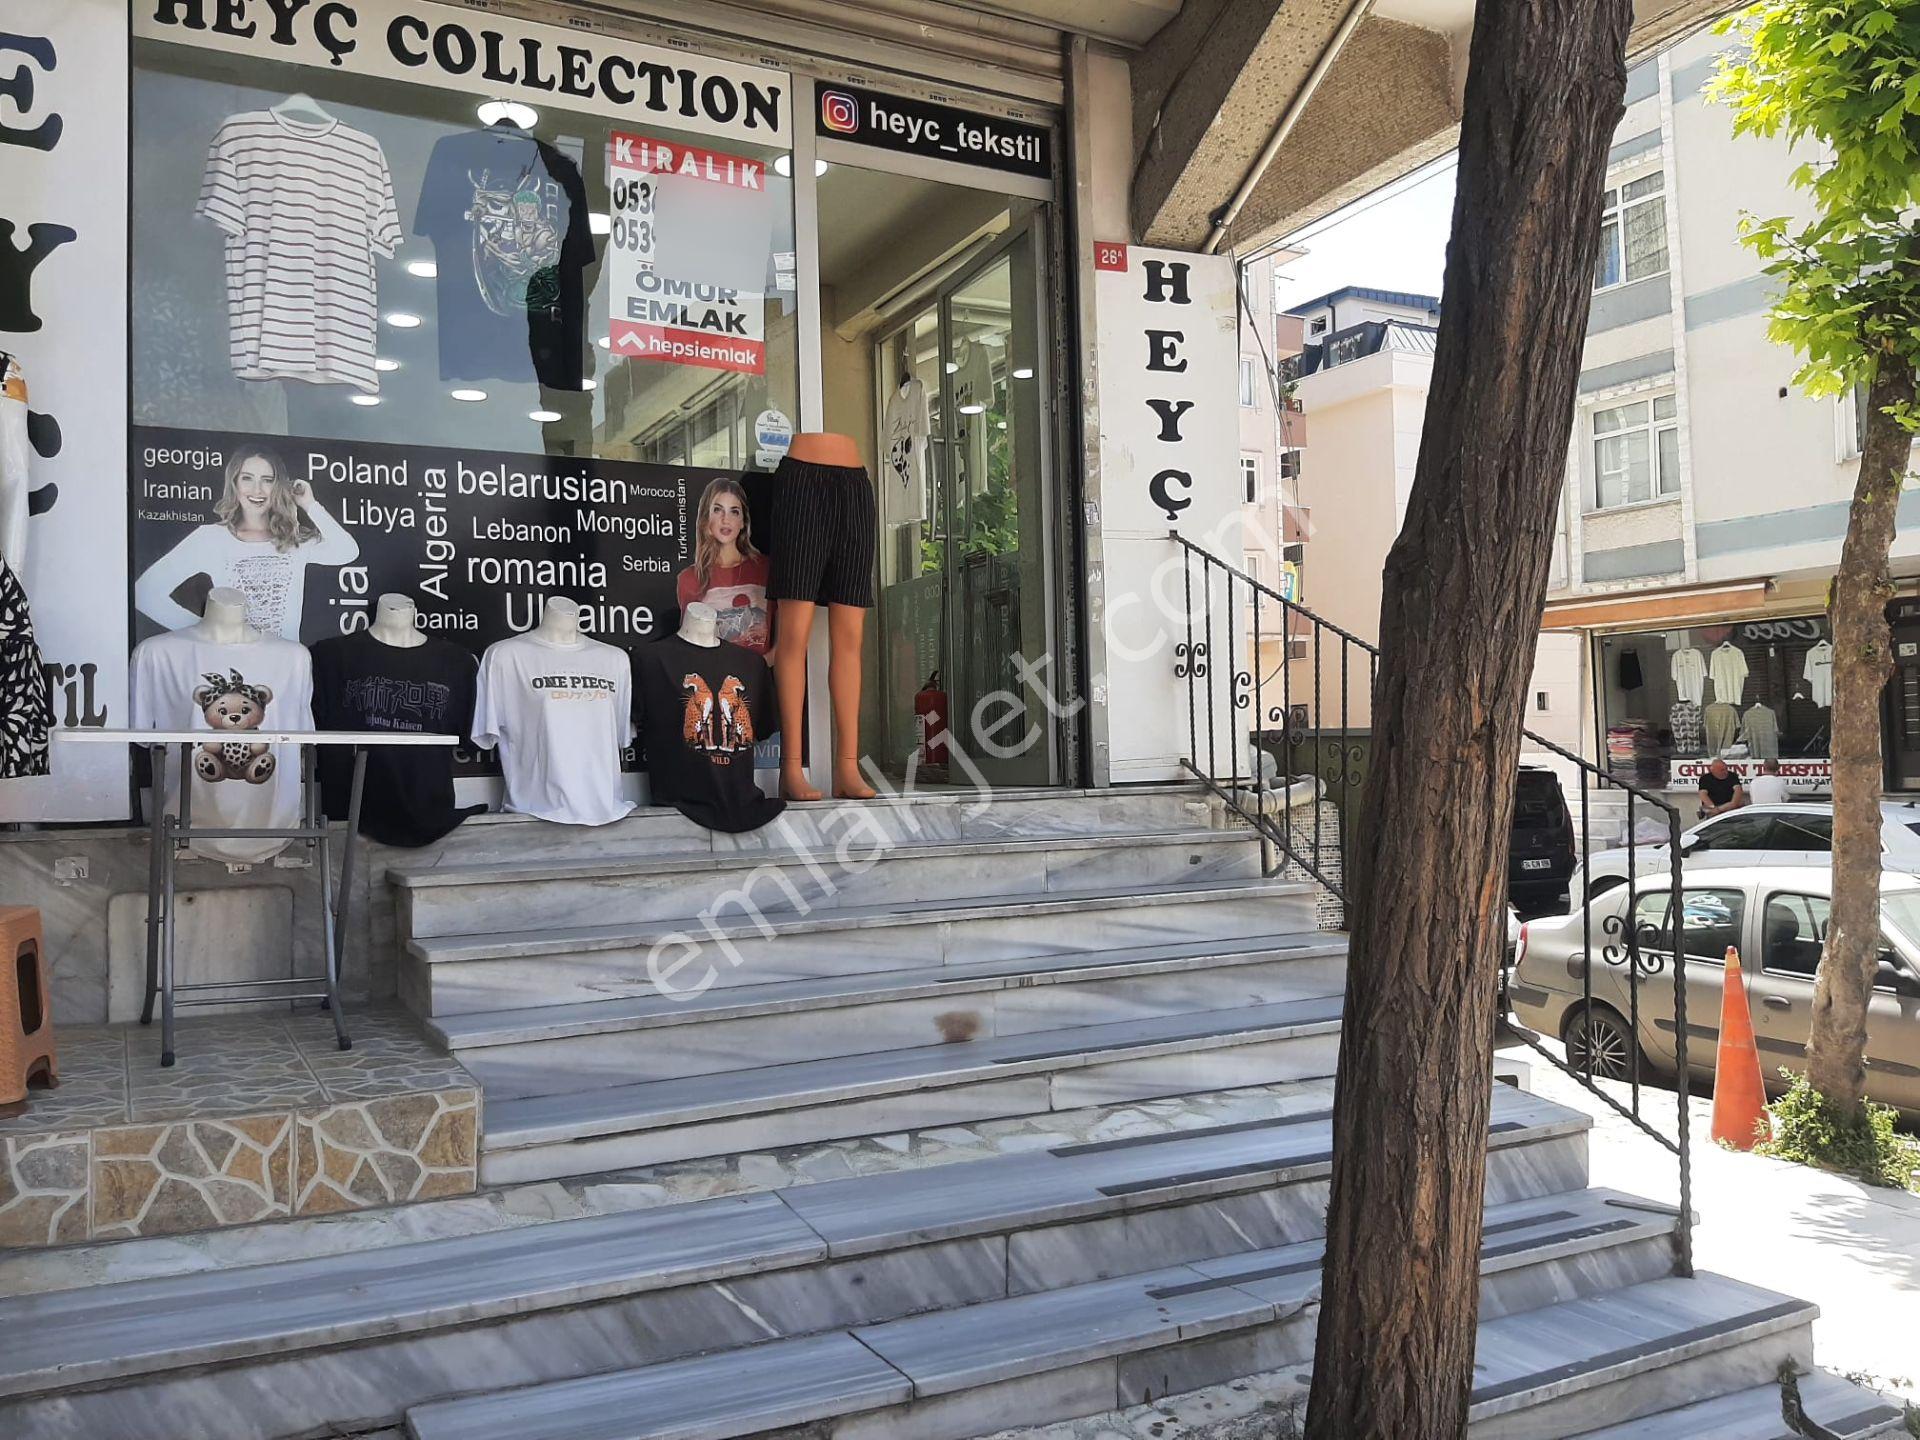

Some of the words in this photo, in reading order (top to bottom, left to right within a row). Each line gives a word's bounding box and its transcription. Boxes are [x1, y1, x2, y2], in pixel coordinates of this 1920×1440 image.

[387, 14, 782, 134] COLLECTION
[870, 102, 1041, 163] heyc_tekstil
[613, 178, 658, 214] 053
[613, 216, 657, 253] 053
[627, 296, 747, 335] EMLAK
[649, 335, 757, 366] hepsiemlak
[143, 447, 224, 470] georgia
[308, 452, 408, 486] Poland
[143, 479, 213, 500] Iranian
[457, 461, 627, 504] belarusian
[630, 484, 676, 498] Morocco
[138, 508, 206, 523] Kazakhistan
[342, 498, 416, 533] Libya
[472, 516, 571, 544] Lebanon
[577, 509, 674, 540] Mongolia
[677, 478, 688, 562] Turkmenistan
[418, 468, 456, 600] Algeria
[467, 553, 608, 588] romania
[623, 555, 671, 573] Serbia
[329, 566, 369, 635] sia
[506, 592, 653, 635] Uaine
[414, 608, 479, 630] bania
[532, 676, 568, 689] ONE
[569, 675, 616, 693] PIECE
